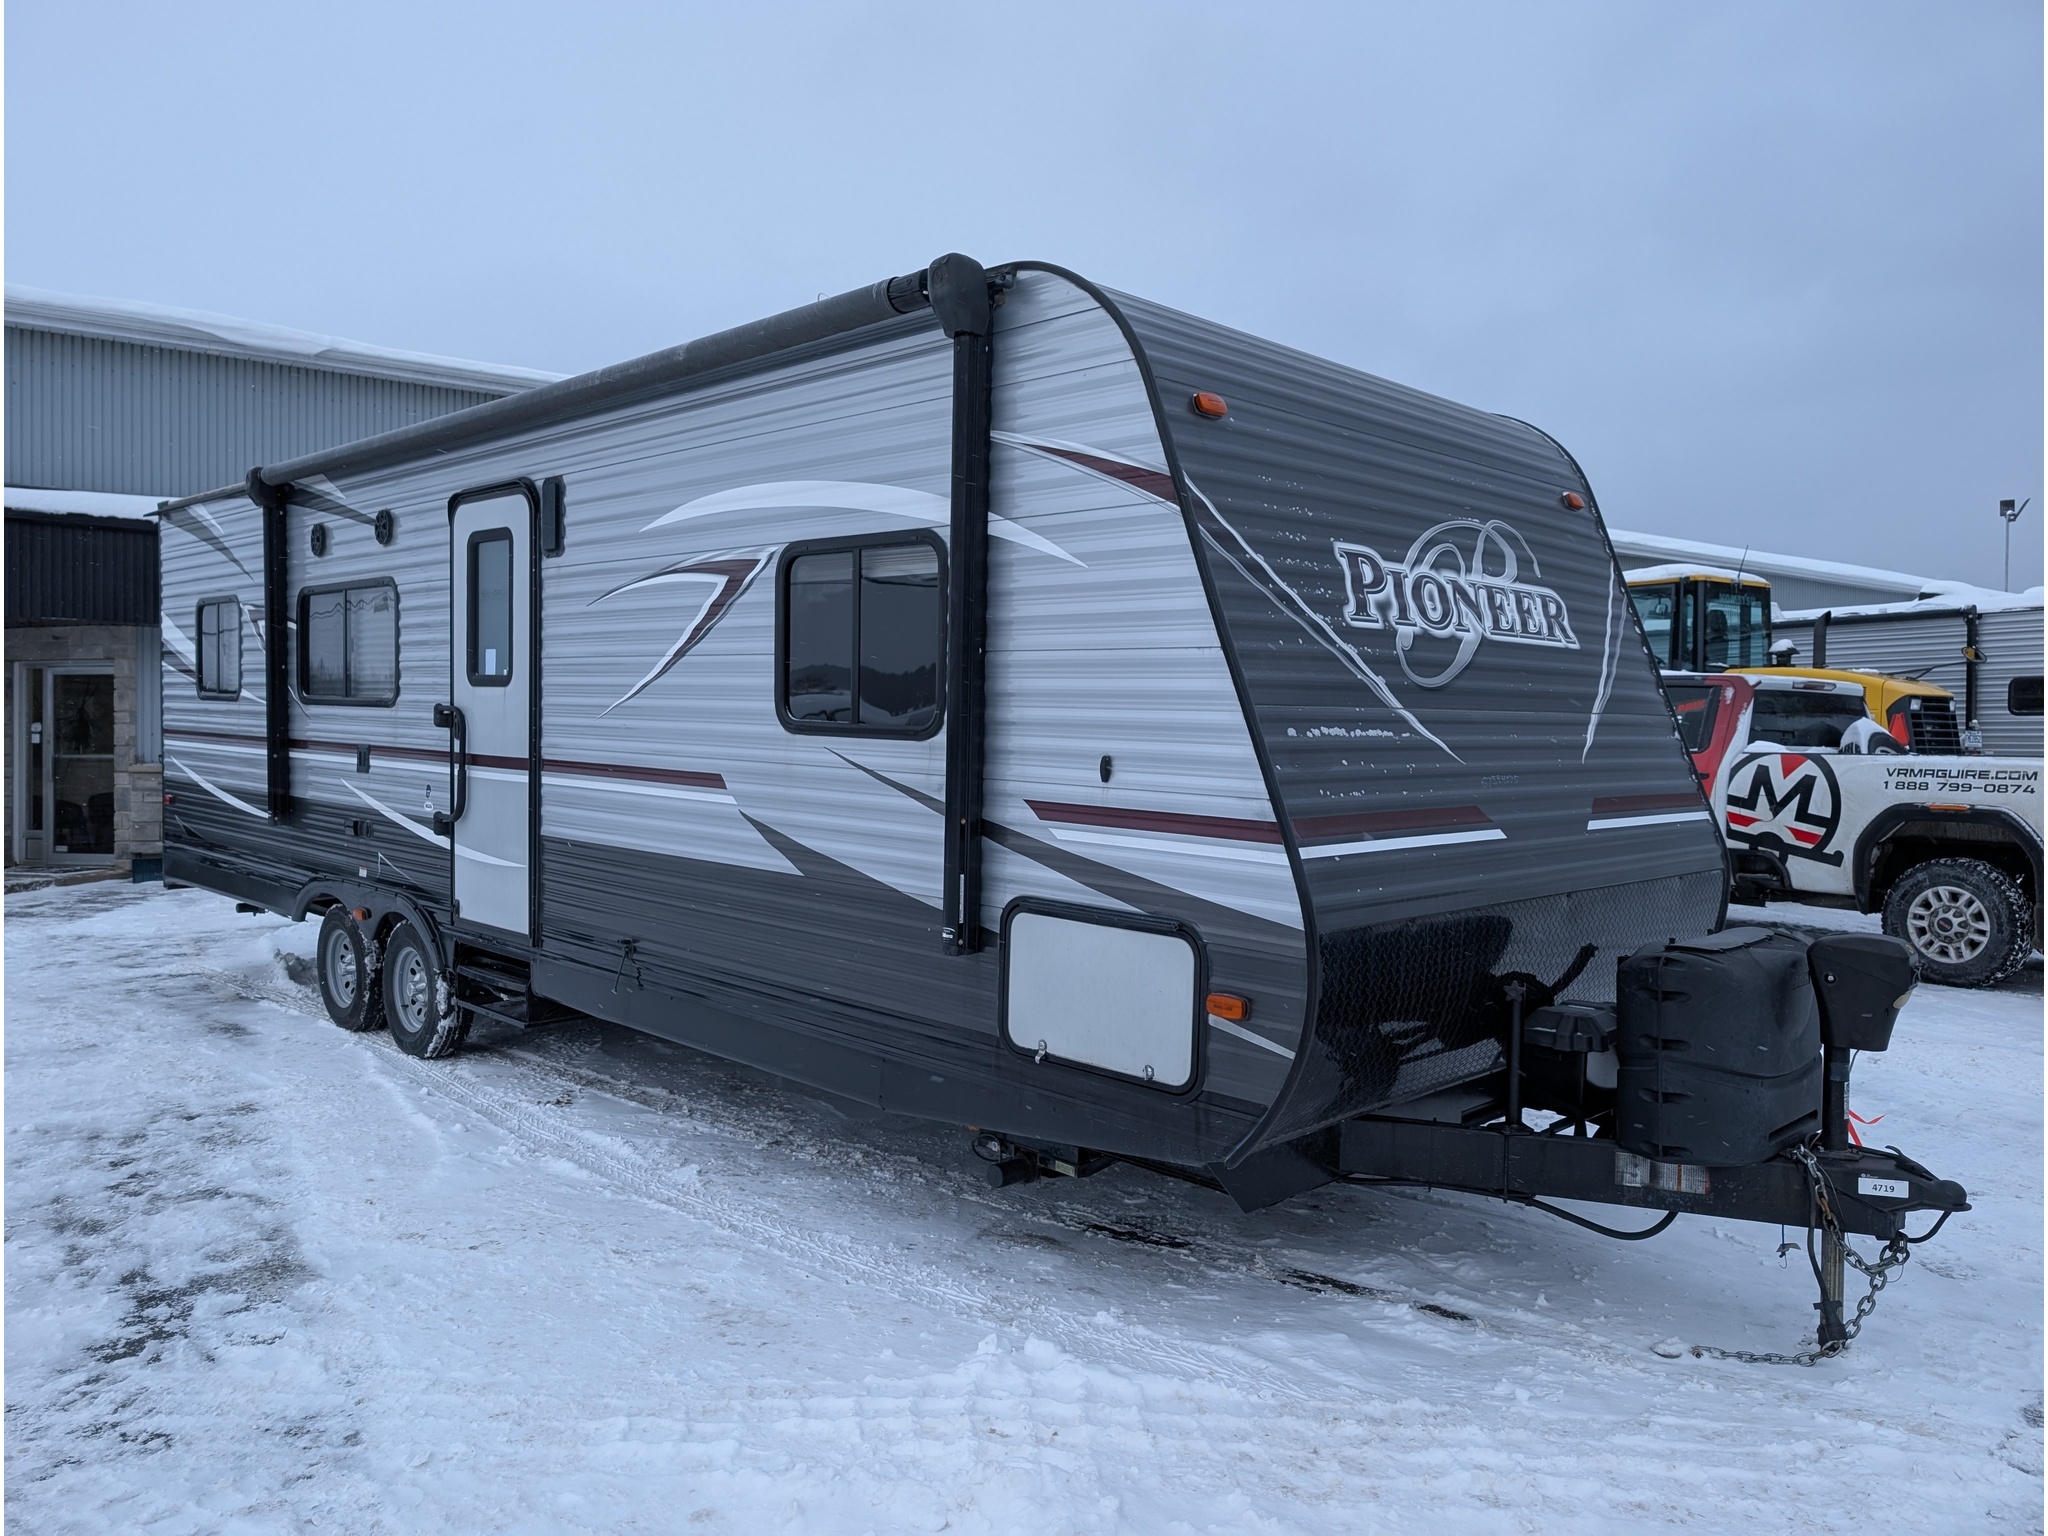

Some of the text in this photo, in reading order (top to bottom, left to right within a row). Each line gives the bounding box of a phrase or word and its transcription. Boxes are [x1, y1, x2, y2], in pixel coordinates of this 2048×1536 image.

[1334, 543, 1579, 648] PIONEER
[1886, 767, 2039, 782] VRMAGUIRE.COM
[1883, 780, 2036, 795] 1 888 799-0874
[1871, 1183, 1896, 1195] 4719
